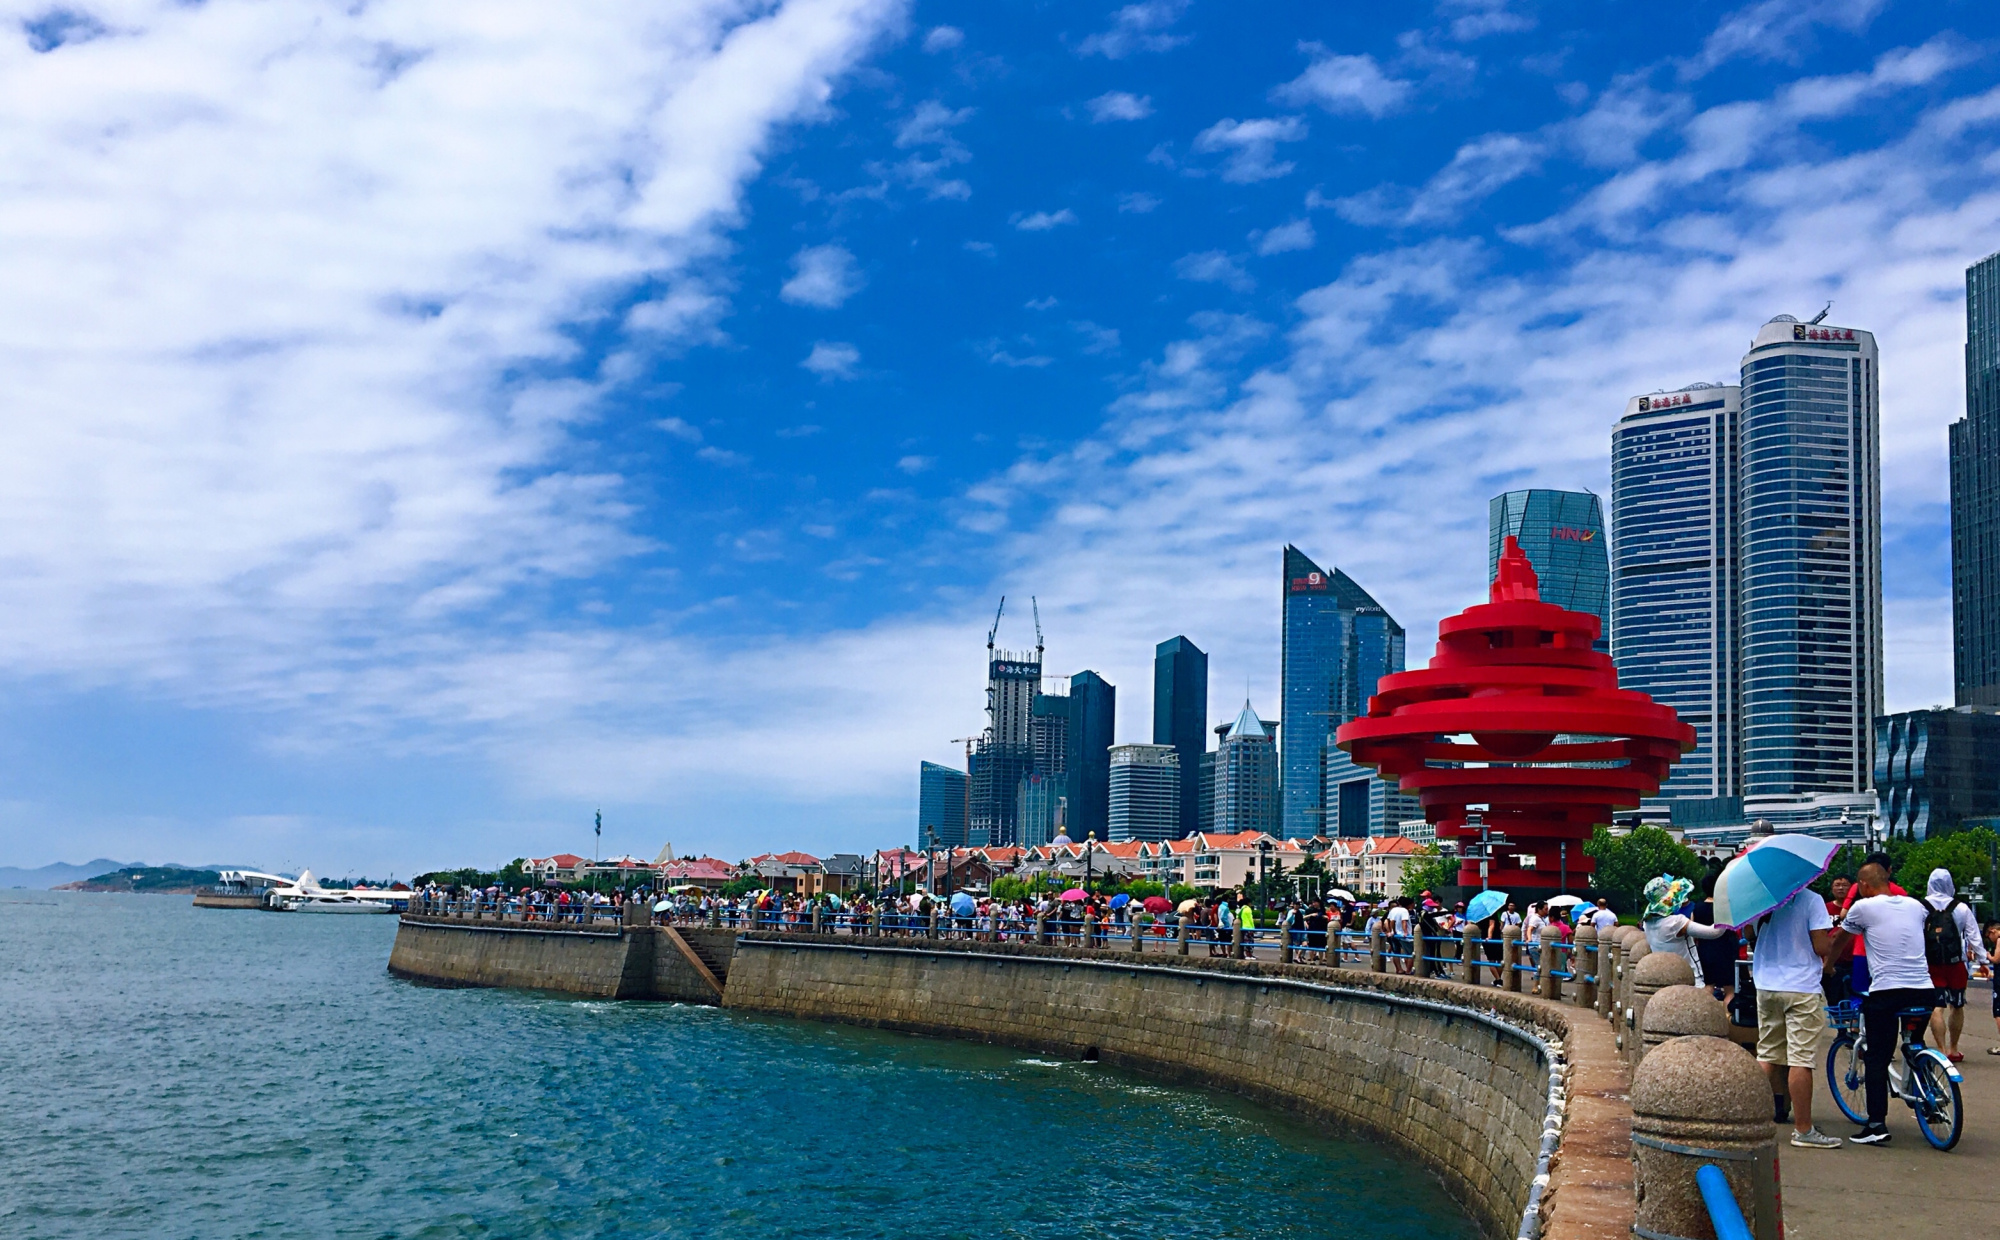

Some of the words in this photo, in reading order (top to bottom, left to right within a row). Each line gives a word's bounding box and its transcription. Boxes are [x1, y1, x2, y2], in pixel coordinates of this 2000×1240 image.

[1551, 526, 1594, 542] HNA
[1005, 665, 1038, 675] 海天中心
